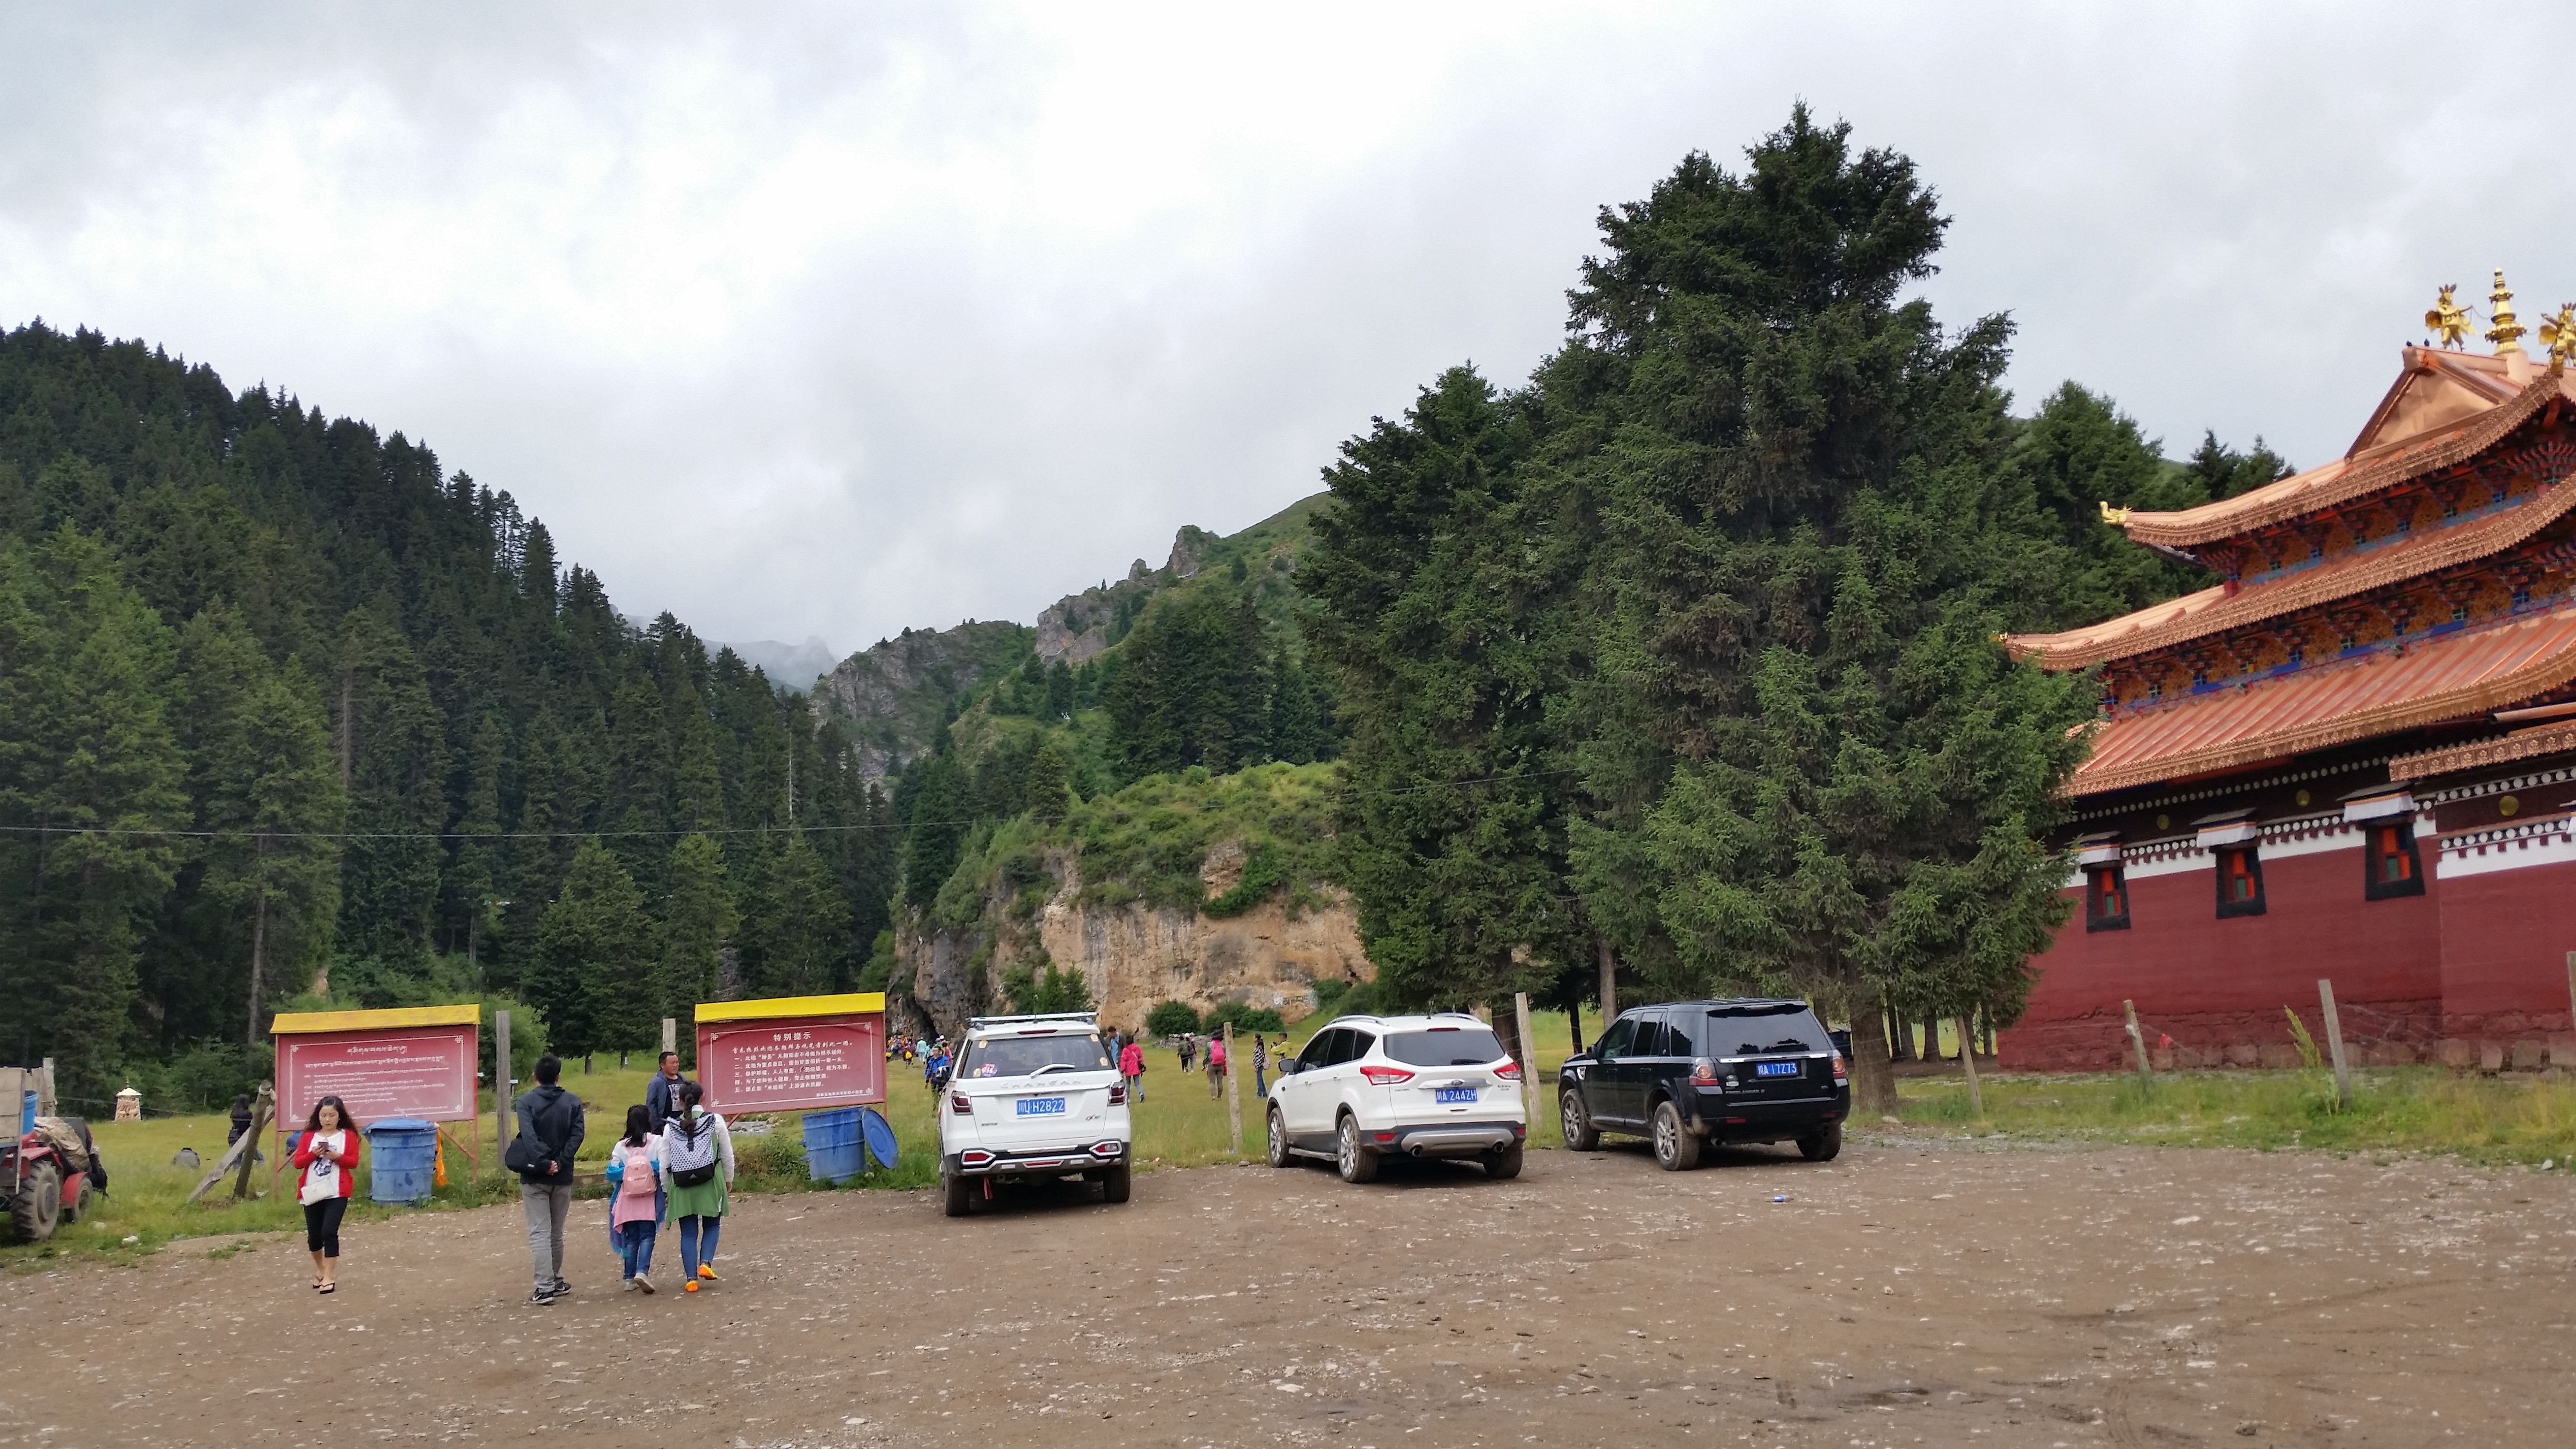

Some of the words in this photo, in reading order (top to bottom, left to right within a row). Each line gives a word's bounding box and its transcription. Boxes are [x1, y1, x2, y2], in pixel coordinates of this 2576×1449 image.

[773, 1031, 811, 1042] 特别提示
[1000, 1078, 1081, 1088] CHANGAN
